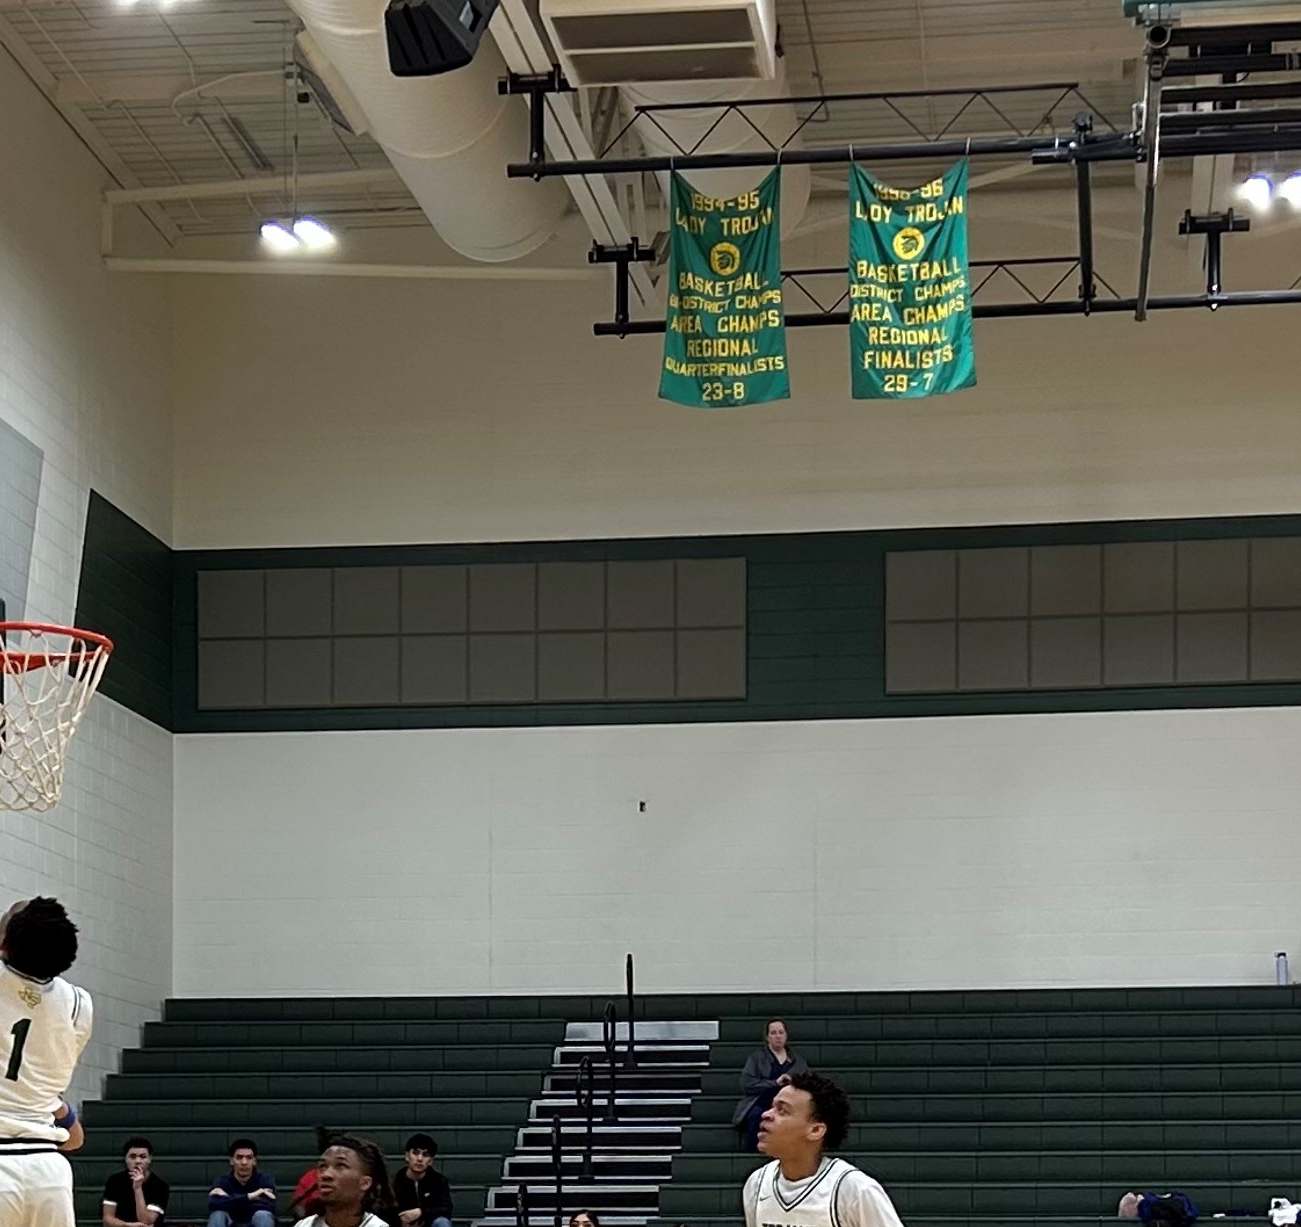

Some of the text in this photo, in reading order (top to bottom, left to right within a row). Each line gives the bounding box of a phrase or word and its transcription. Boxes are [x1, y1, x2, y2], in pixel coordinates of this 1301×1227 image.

[855, 195, 963, 224] LDY TROJN
[857, 256, 961, 283] BASKETBALL
[680, 272, 769, 297] BASKETBAL
[914, 277, 966, 301] CHAMPS
[670, 309, 780, 333] AREA CHAMPS
[851, 294, 965, 325] AREA CHAMPS
[687, 338, 758, 357] REGIONAL
[868, 326, 948, 345] REGIONAL
[665, 356, 785, 377] QUARTERFINALISTS
[864, 344, 953, 369] FINALISTS
[5, 1018, 32, 1082] 1
